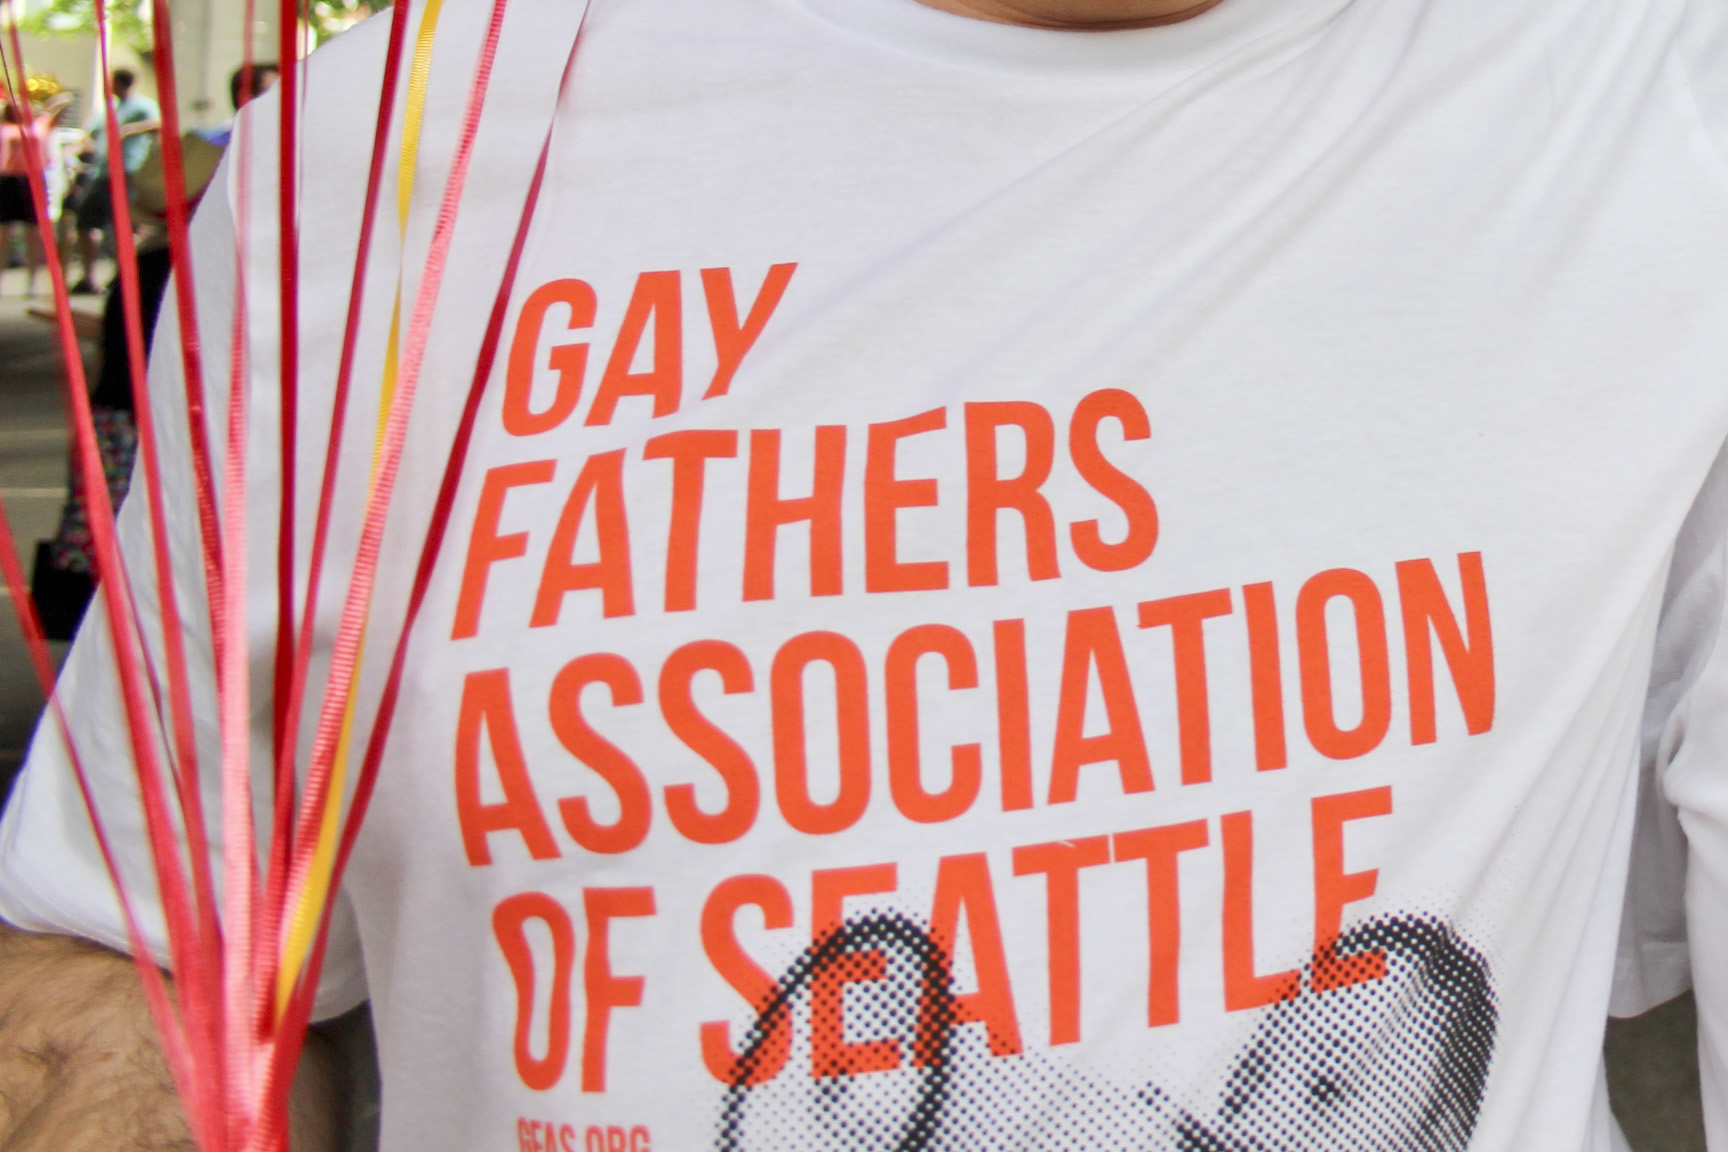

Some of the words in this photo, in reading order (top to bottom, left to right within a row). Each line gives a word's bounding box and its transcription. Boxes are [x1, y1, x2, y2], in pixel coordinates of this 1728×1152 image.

[500, 262, 798, 437] GAY
[450, 388, 1159, 641] FATHERS
[454, 551, 1496, 867] ASSOCIATION
[491, 886, 656, 1093] OF
[699, 785, 1393, 1088] SEATTLE
